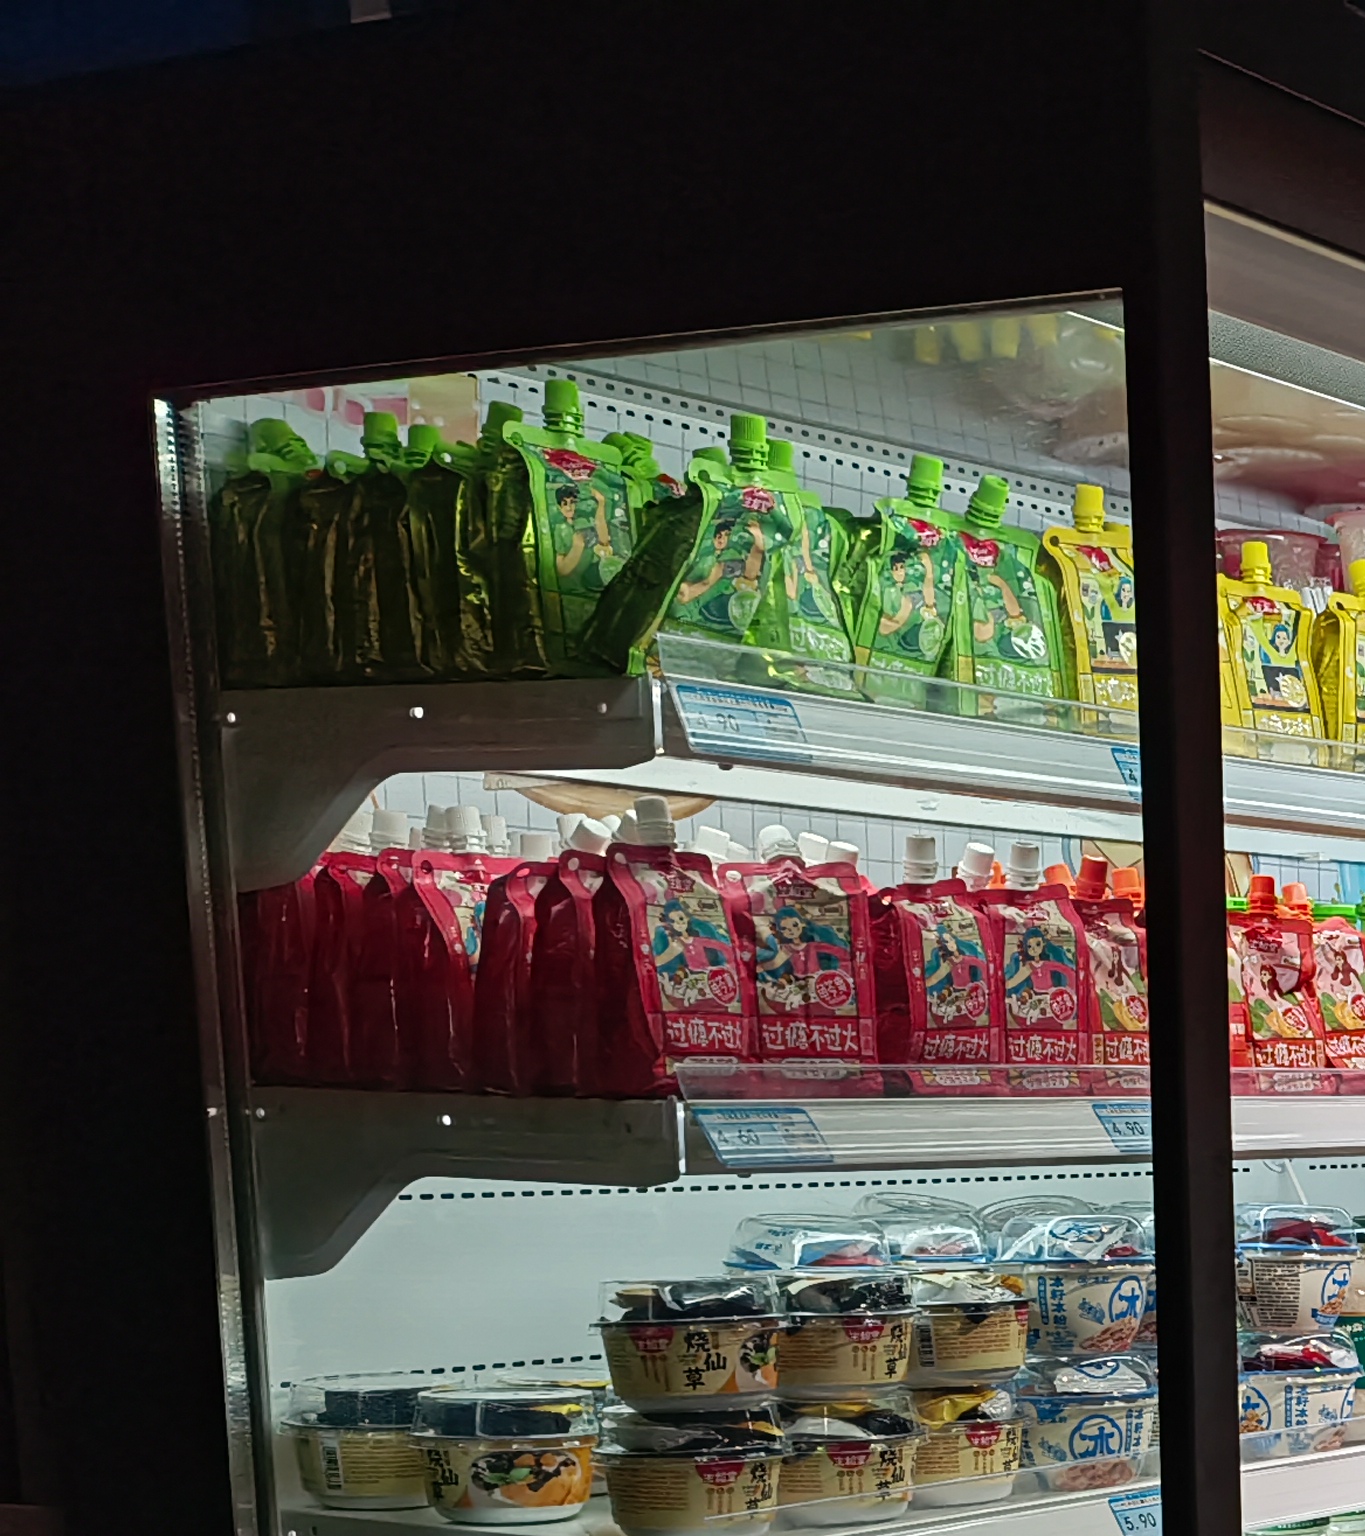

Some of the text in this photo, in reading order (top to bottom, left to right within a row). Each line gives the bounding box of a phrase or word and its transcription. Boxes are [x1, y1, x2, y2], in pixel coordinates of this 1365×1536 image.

[762, 1020, 859, 1052] 过瘾不过火
[924, 1033, 989, 1061] 过瘾不过火
[1007, 1034, 1076, 1062] 过瘾不过火
[1112, 1121, 1144, 1136] 4.90
[683, 1331, 727, 1390] 烧仙草
[1124, 1512, 1157, 1532] 5.90
